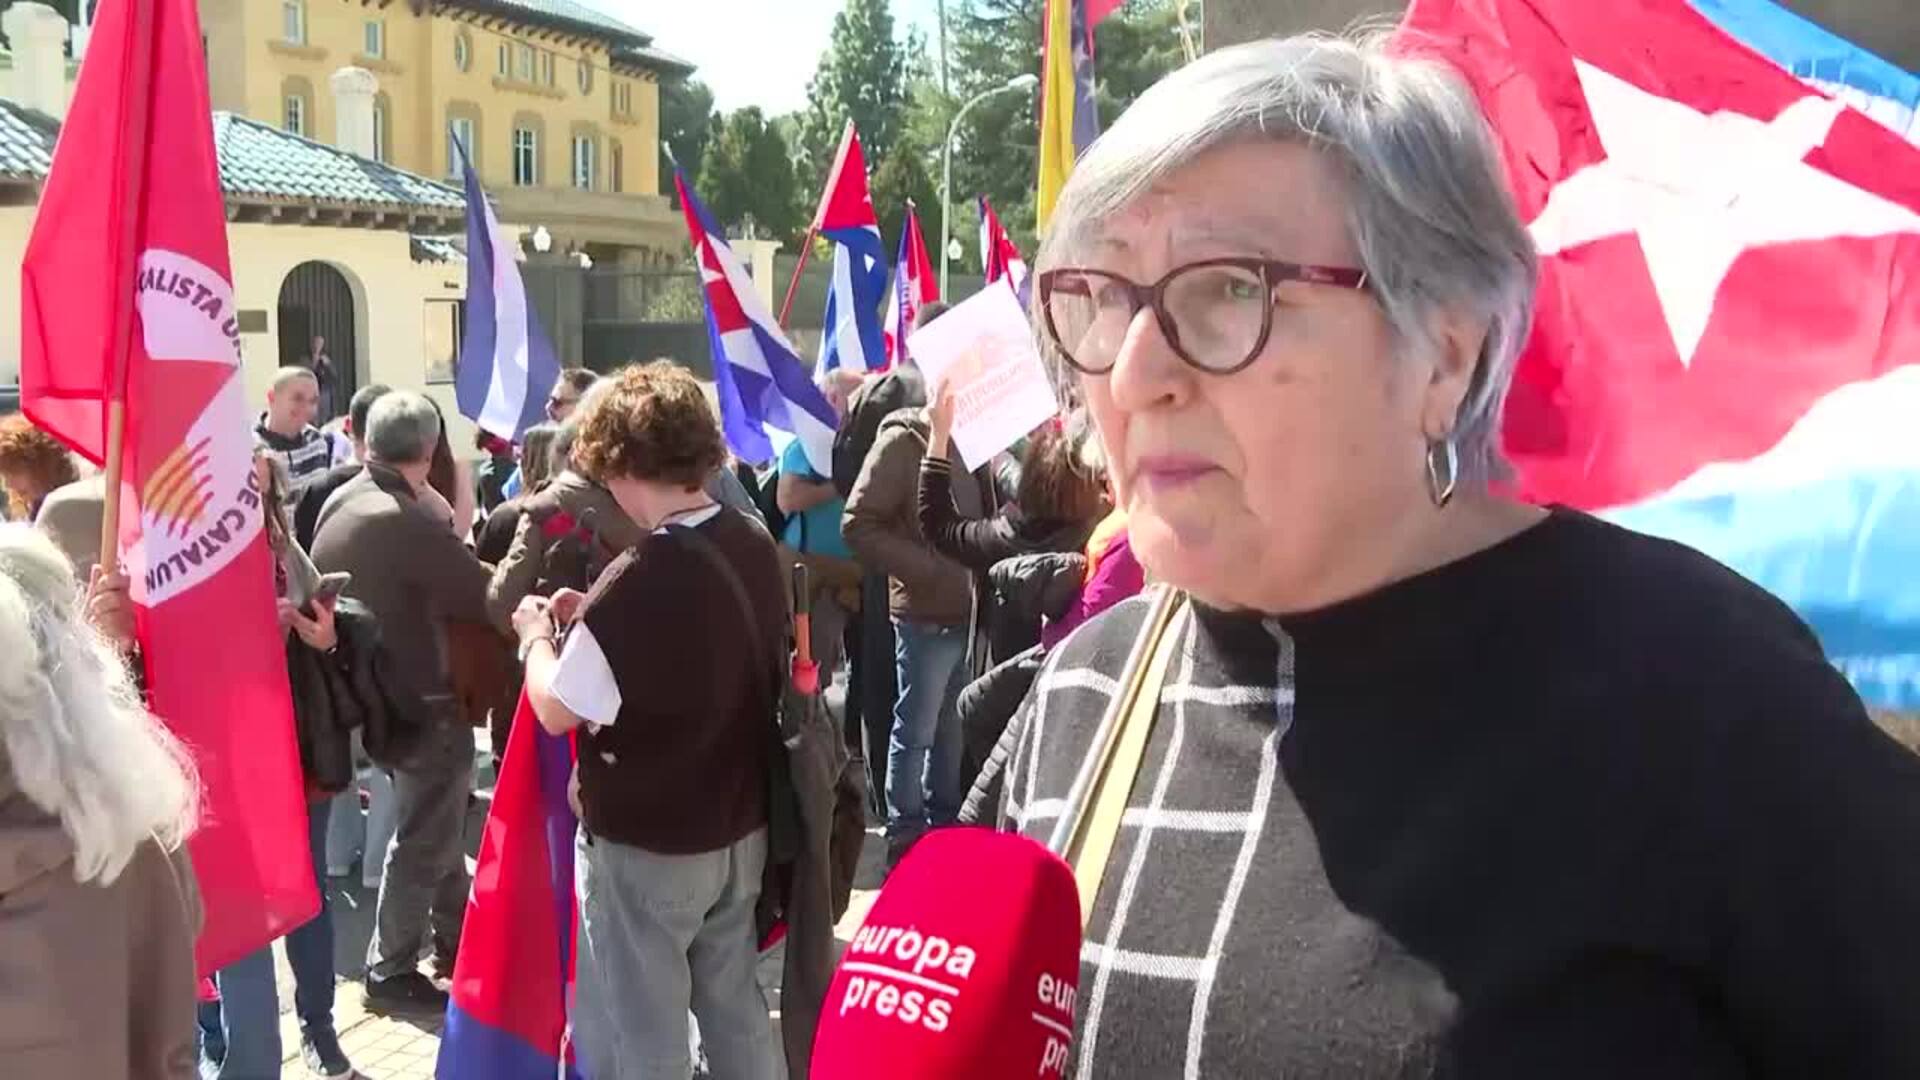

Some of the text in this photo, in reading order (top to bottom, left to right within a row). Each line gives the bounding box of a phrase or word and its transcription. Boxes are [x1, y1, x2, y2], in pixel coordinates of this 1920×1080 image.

[851, 925, 976, 979] europa
[840, 976, 952, 1032] press
[1037, 972, 1077, 1020] eur
